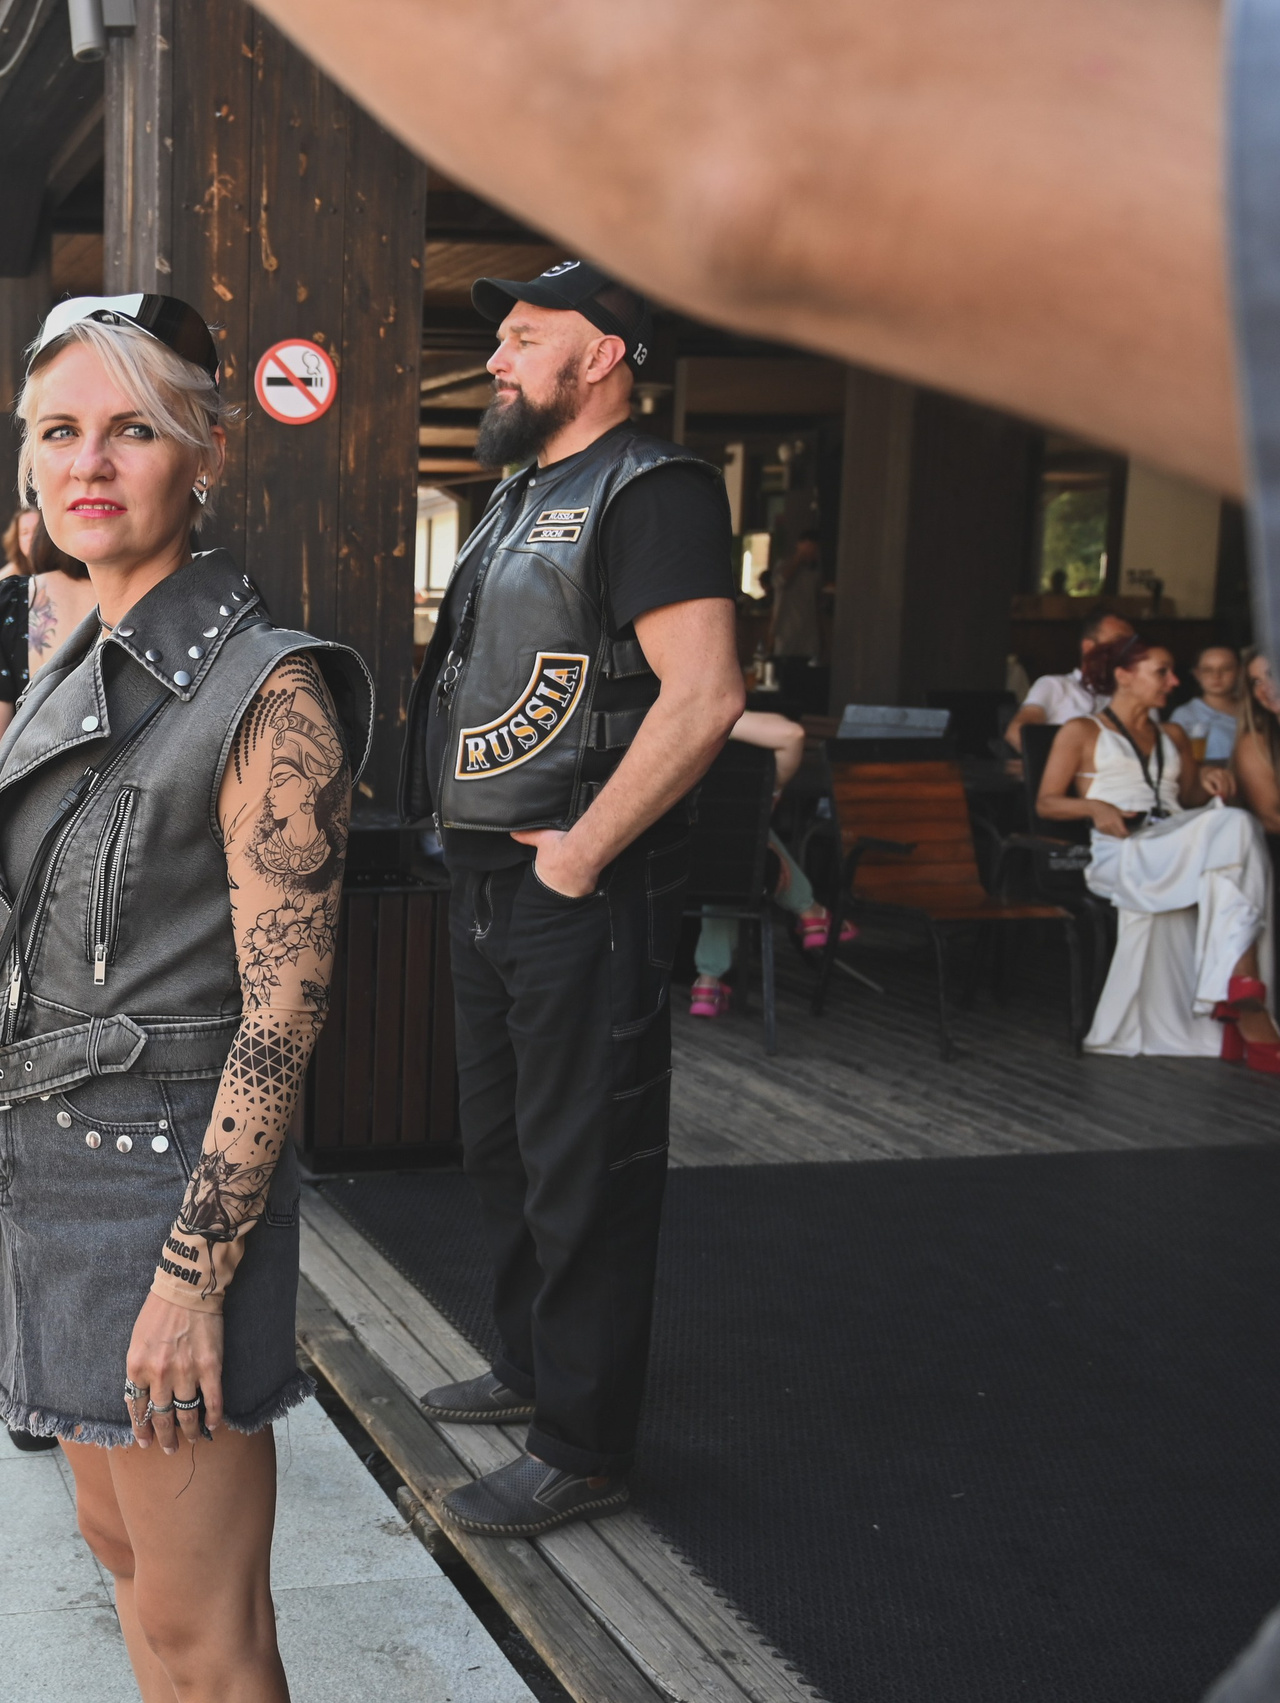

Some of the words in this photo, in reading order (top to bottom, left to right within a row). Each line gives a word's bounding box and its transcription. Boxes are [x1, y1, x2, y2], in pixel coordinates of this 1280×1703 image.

[633, 342, 648, 365] 13
[548, 512, 575, 520] RUSSIA
[540, 529, 564, 538] SOCHI
[465, 666, 580, 771] RUSSIA
[157, 1256, 202, 1286] ourself
